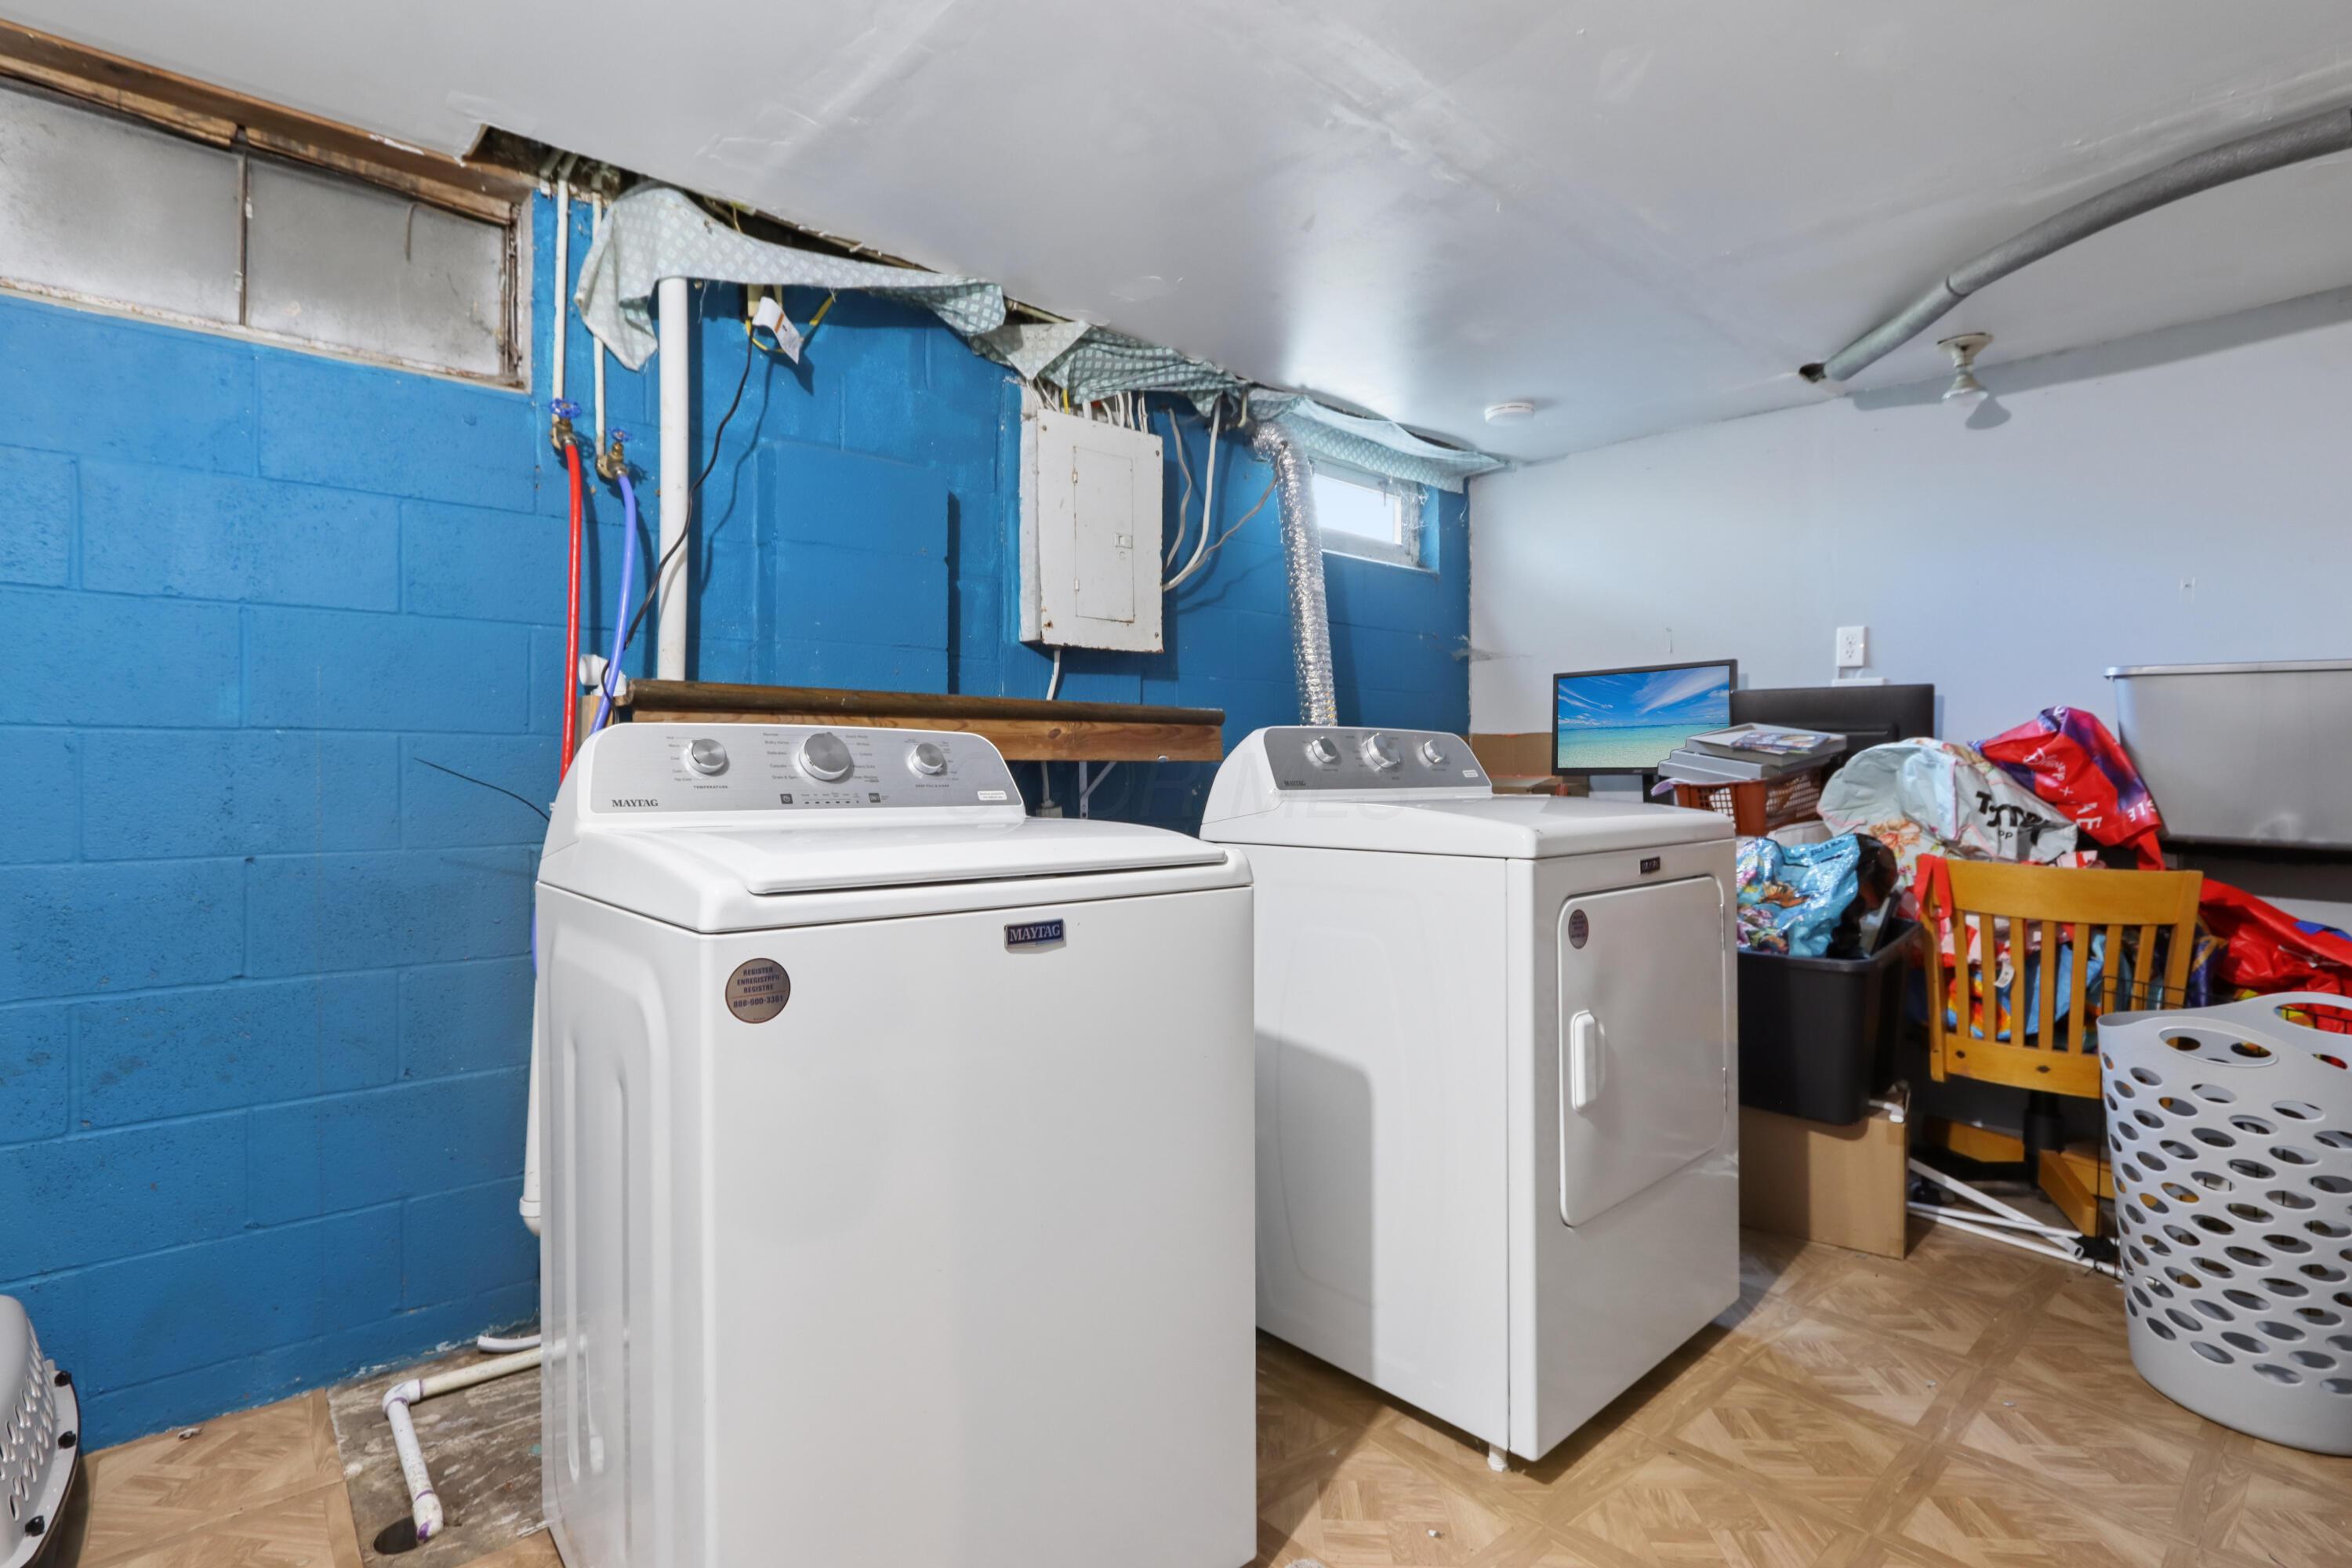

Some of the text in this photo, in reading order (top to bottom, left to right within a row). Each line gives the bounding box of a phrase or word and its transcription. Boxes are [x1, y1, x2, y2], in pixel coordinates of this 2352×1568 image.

[612, 799, 659, 808] MAYTAG
[1009, 924, 1060, 942] MAYTAG
[743, 966, 773, 976] REGISTER
